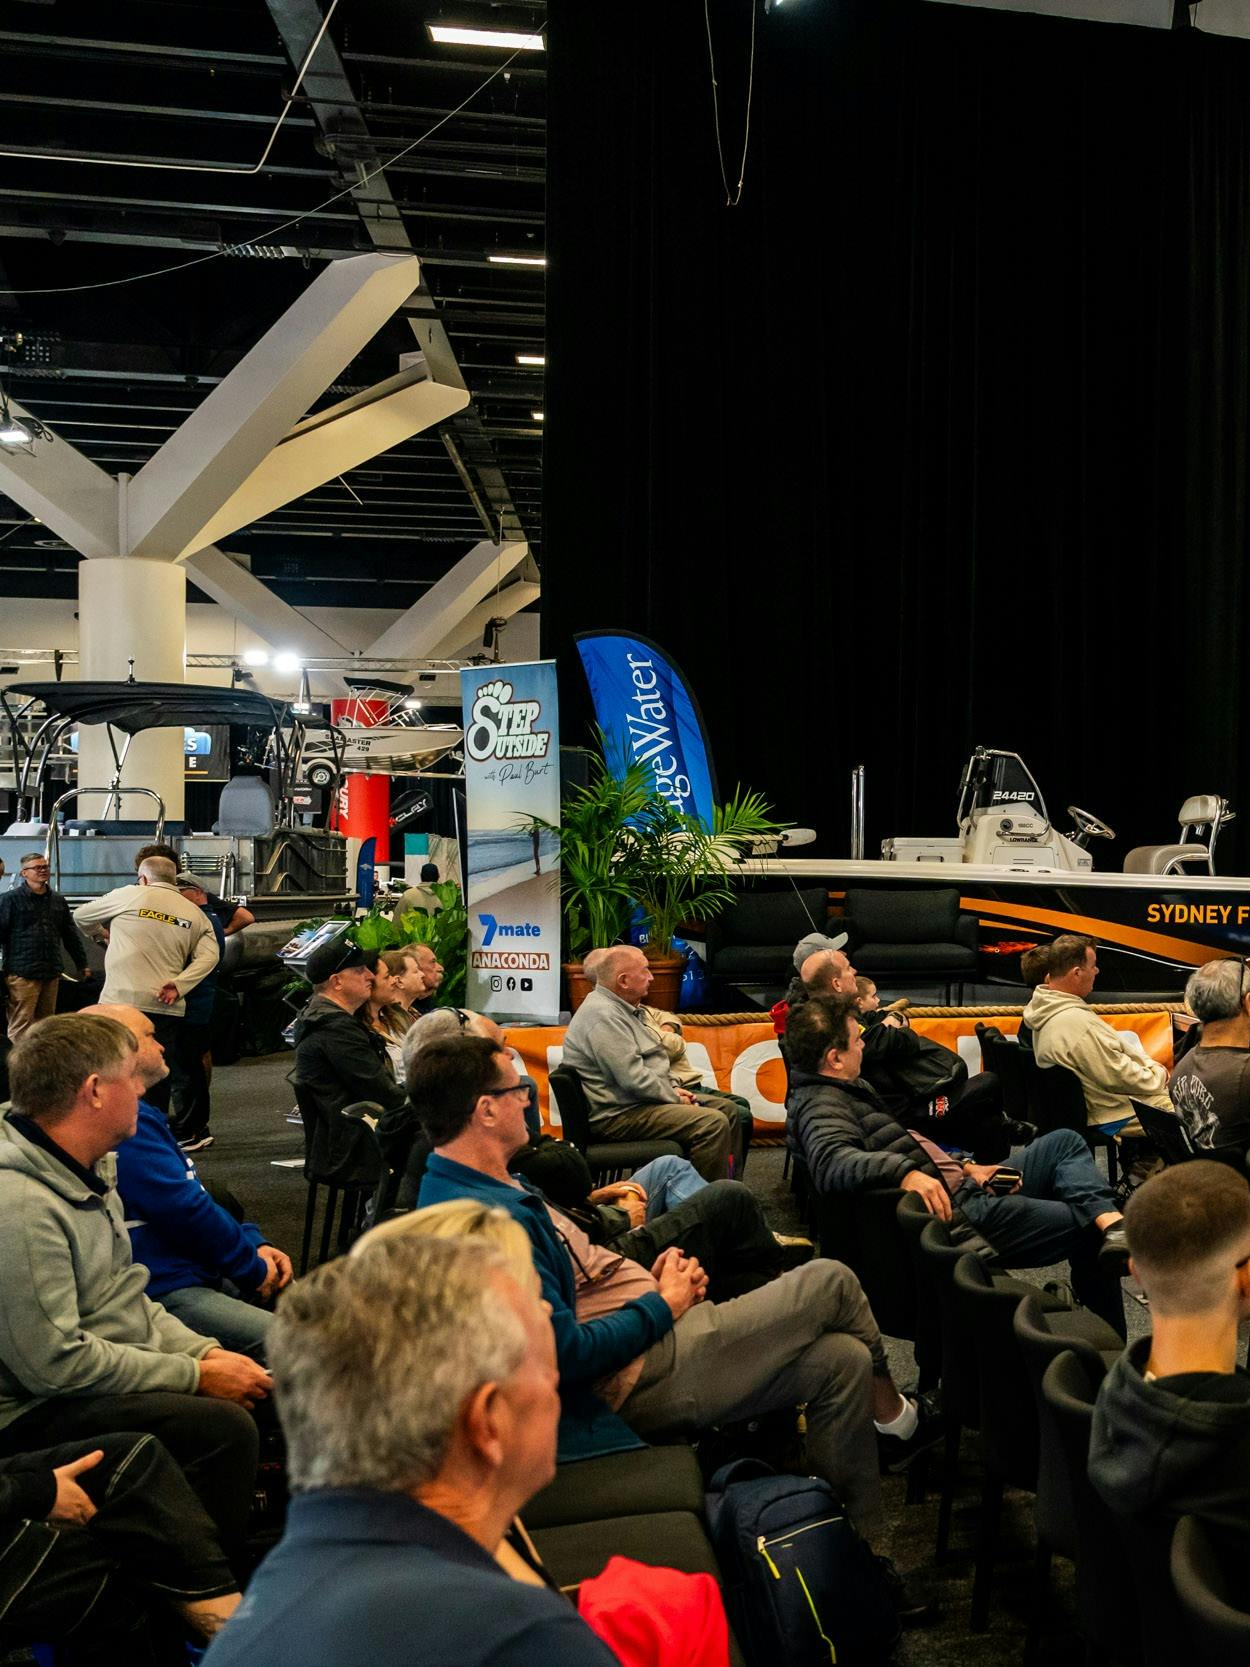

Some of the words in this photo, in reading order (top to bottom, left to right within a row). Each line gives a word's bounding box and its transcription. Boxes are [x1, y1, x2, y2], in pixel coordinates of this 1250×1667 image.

[472, 695, 540, 736] STEP
[993, 791, 1035, 801] 24420
[140, 909, 175, 924] EAGLE
[1147, 903, 1232, 925] SYDNEY
[472, 952, 549, 969] ANACONDA
